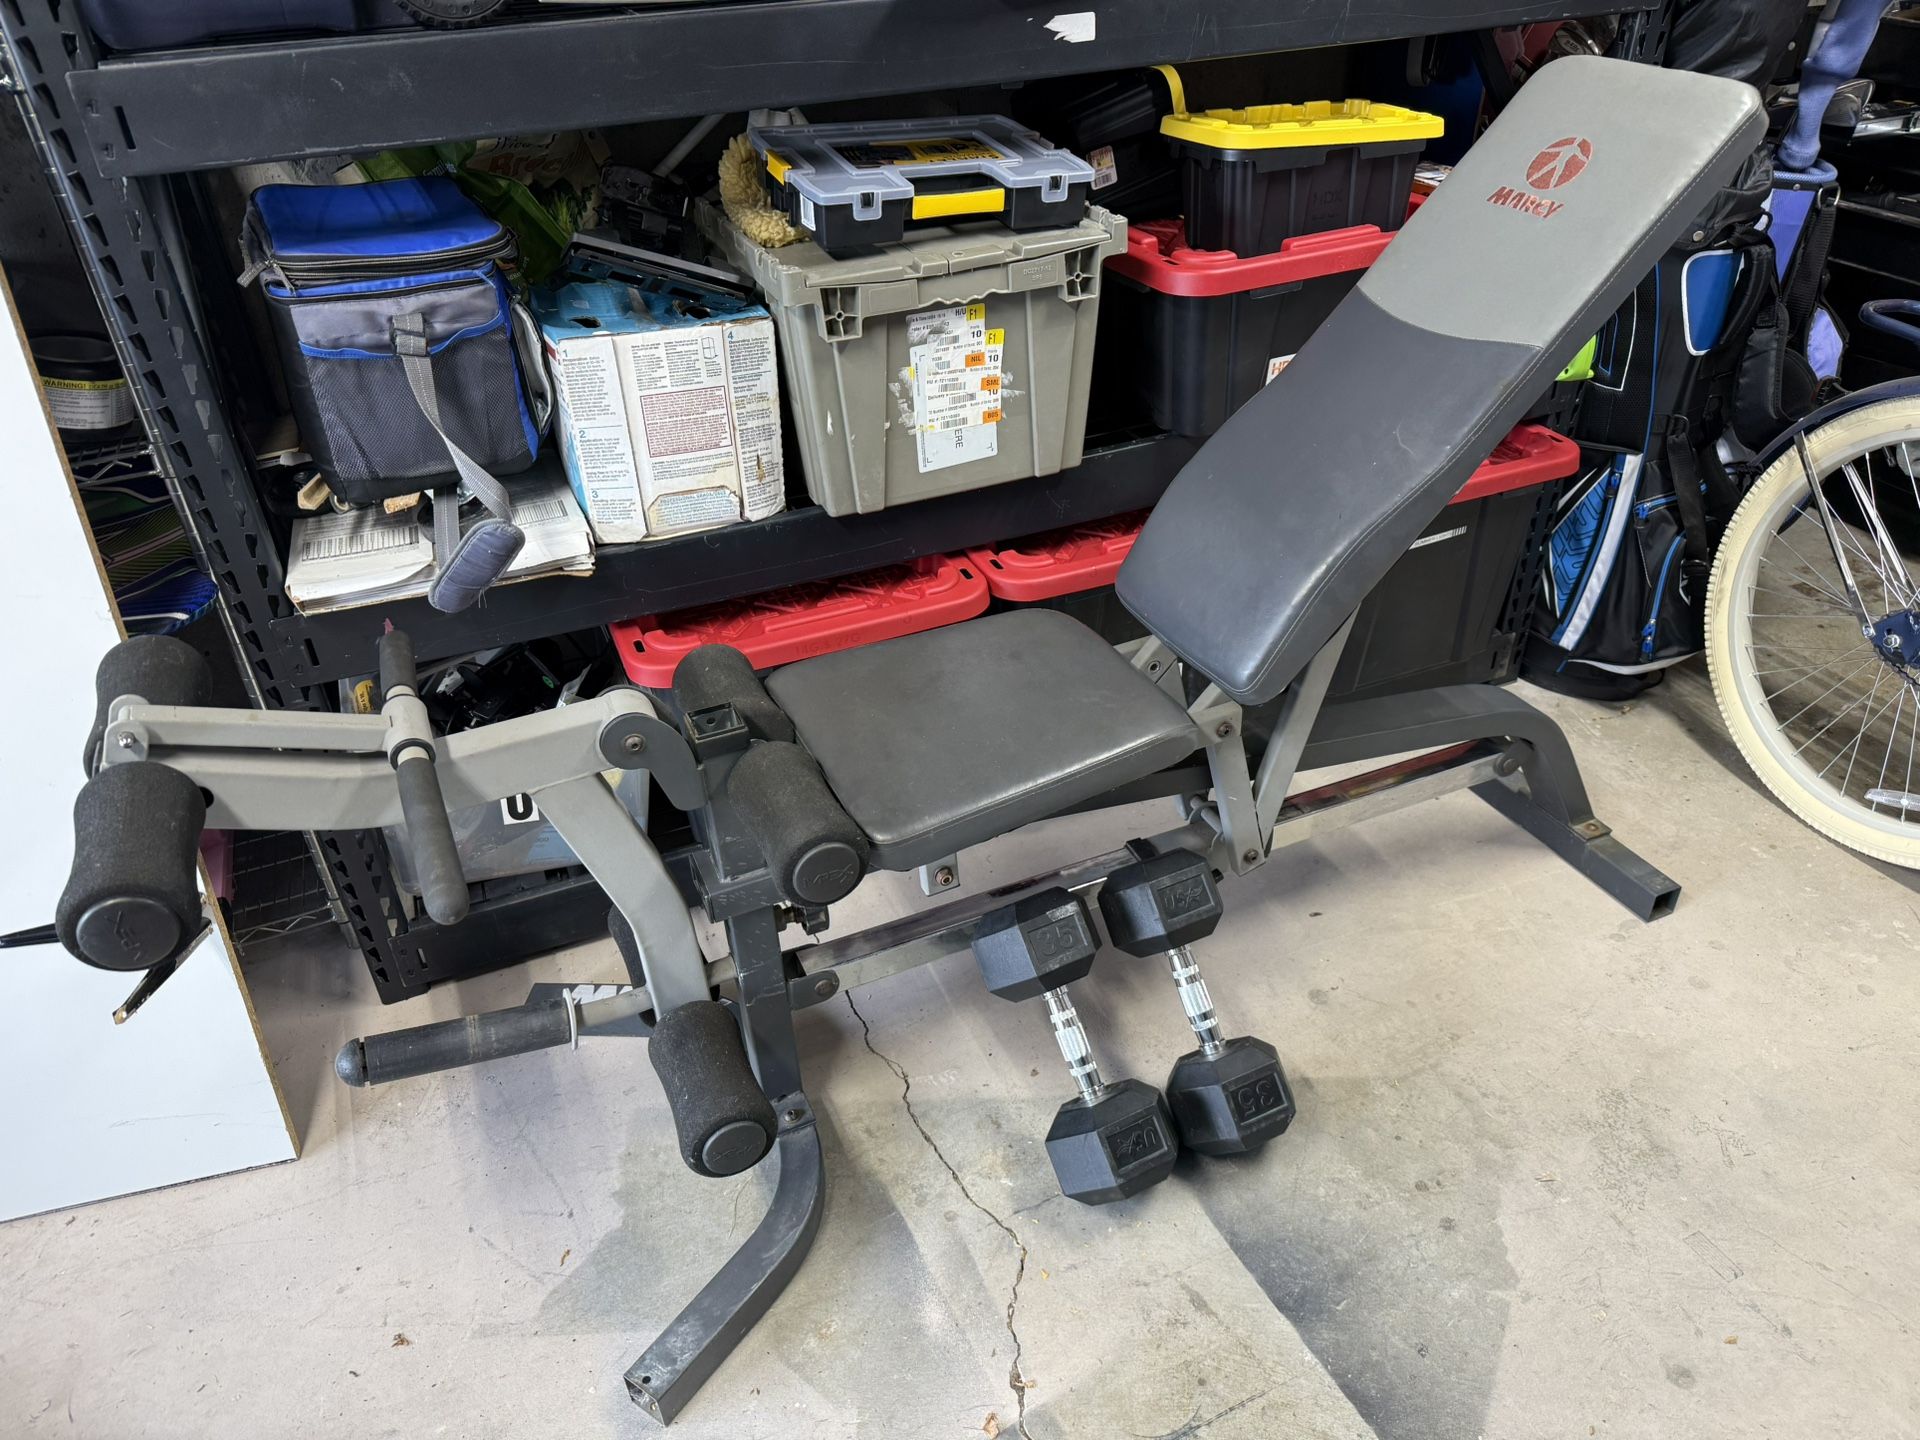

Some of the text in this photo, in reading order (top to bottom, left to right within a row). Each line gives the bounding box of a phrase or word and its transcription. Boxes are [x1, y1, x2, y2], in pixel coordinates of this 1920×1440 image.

[969, 309, 977, 320] F1
[728, 331, 734, 340] 4
[971, 329, 982, 339] 10
[988, 332, 996, 344] F1
[988, 354, 999, 362] 10
[44, 378, 87, 389] WARNING!
[578, 430, 586, 438] 2
[592, 490, 599, 498] 3
